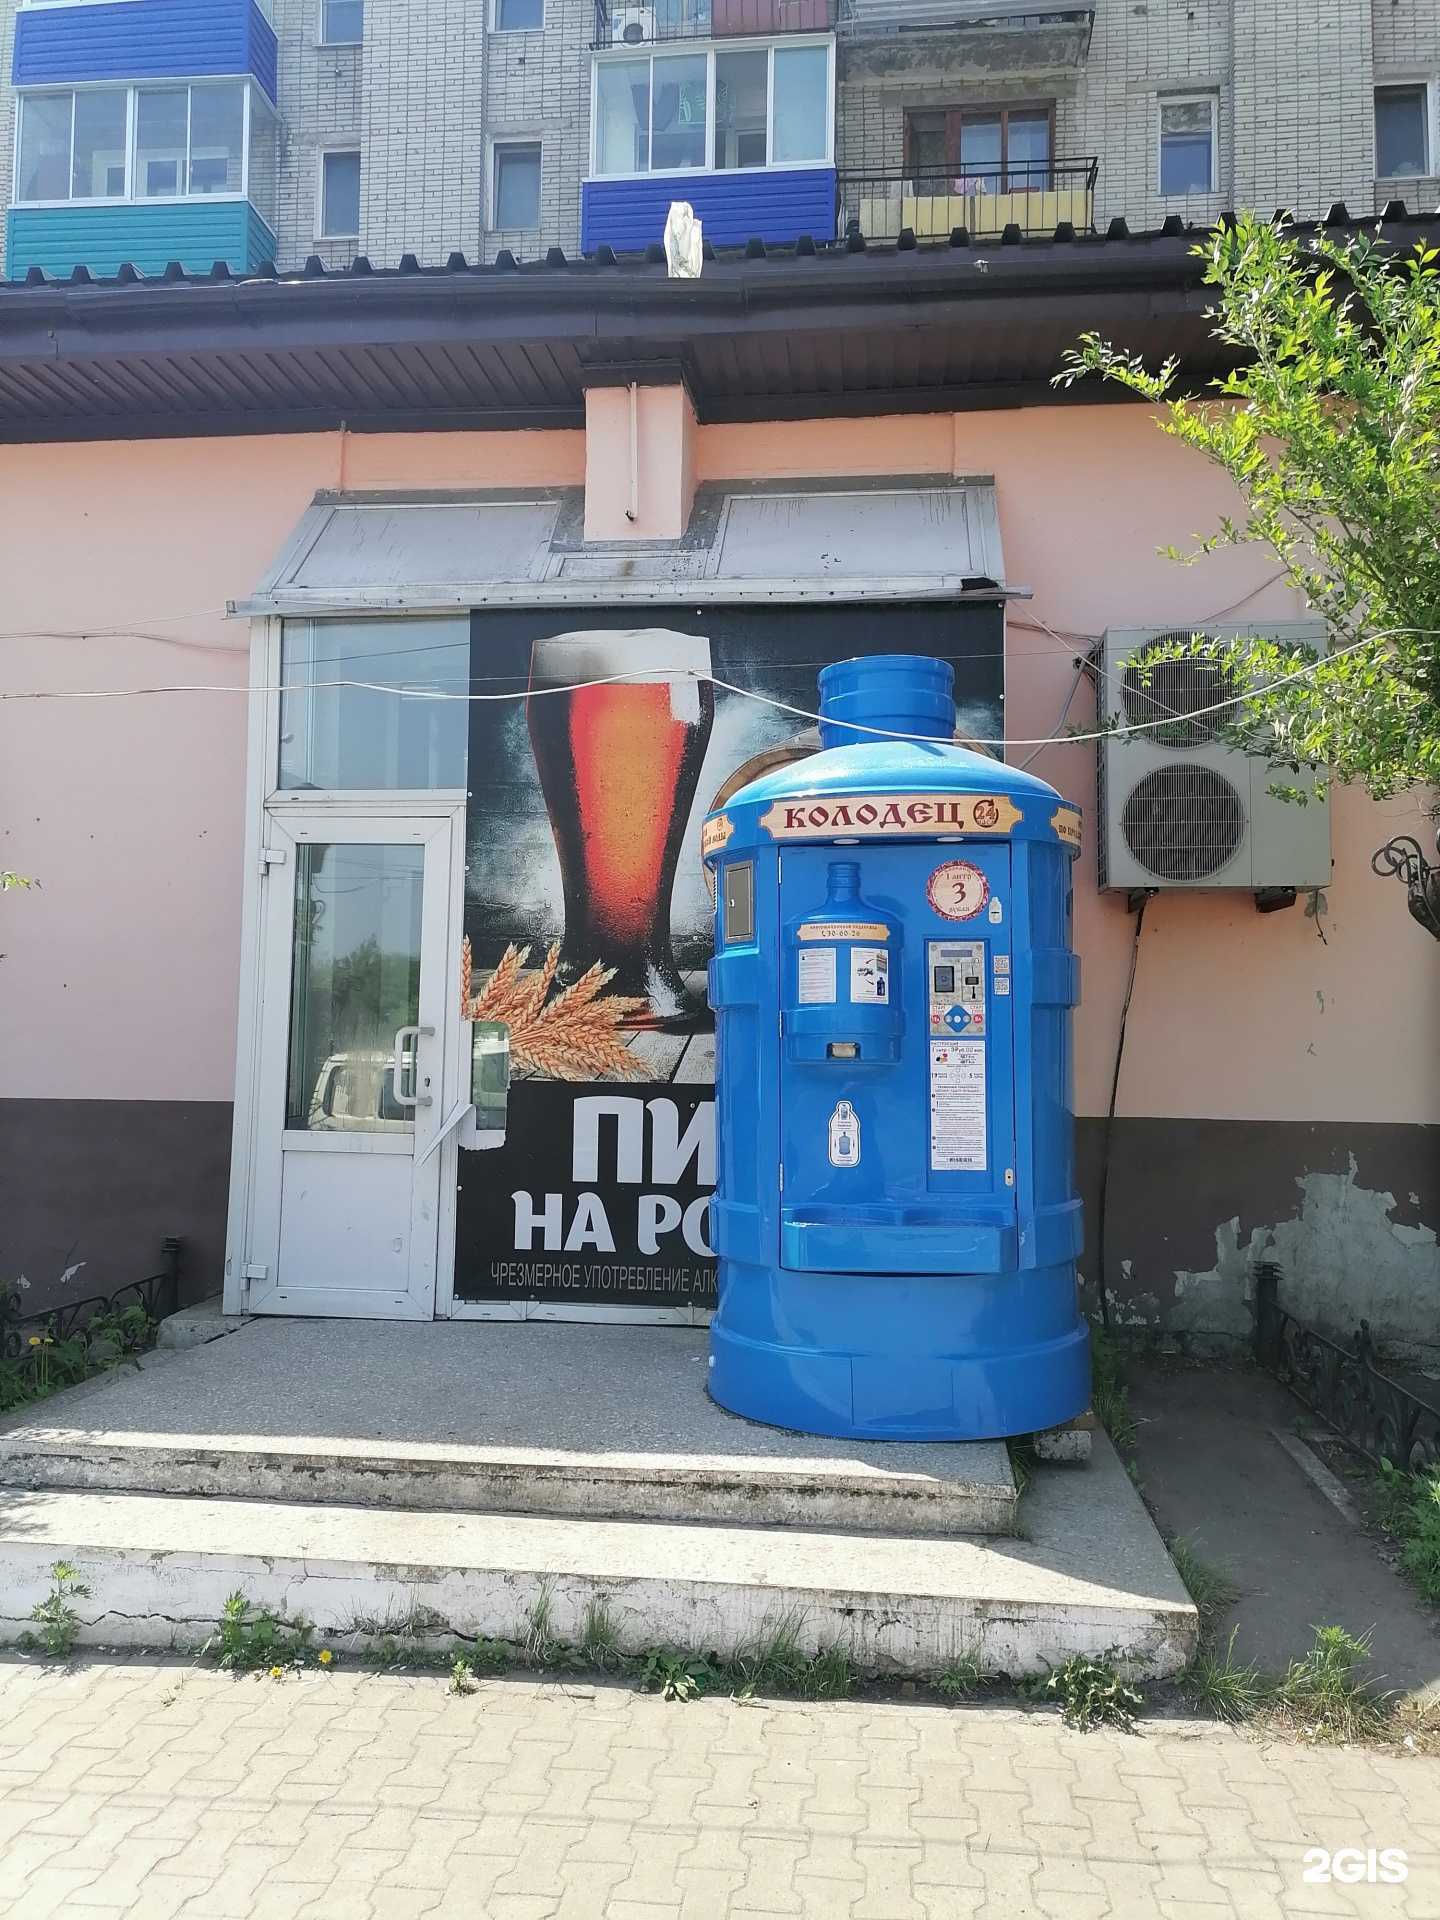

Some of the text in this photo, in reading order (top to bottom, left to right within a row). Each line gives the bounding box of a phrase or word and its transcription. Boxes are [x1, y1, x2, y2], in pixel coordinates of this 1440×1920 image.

[784, 802, 965, 829] КОЛОДЕЦ
[976, 805, 996, 819] 24
[952, 882, 967, 904] 3
[511, 1190, 616, 1252] НА
[491, 1262, 580, 1288] ЧРЕЗМЕРНОЕ
[584, 1265, 689, 1292] УПОТРЕБЛЕНИЕ
